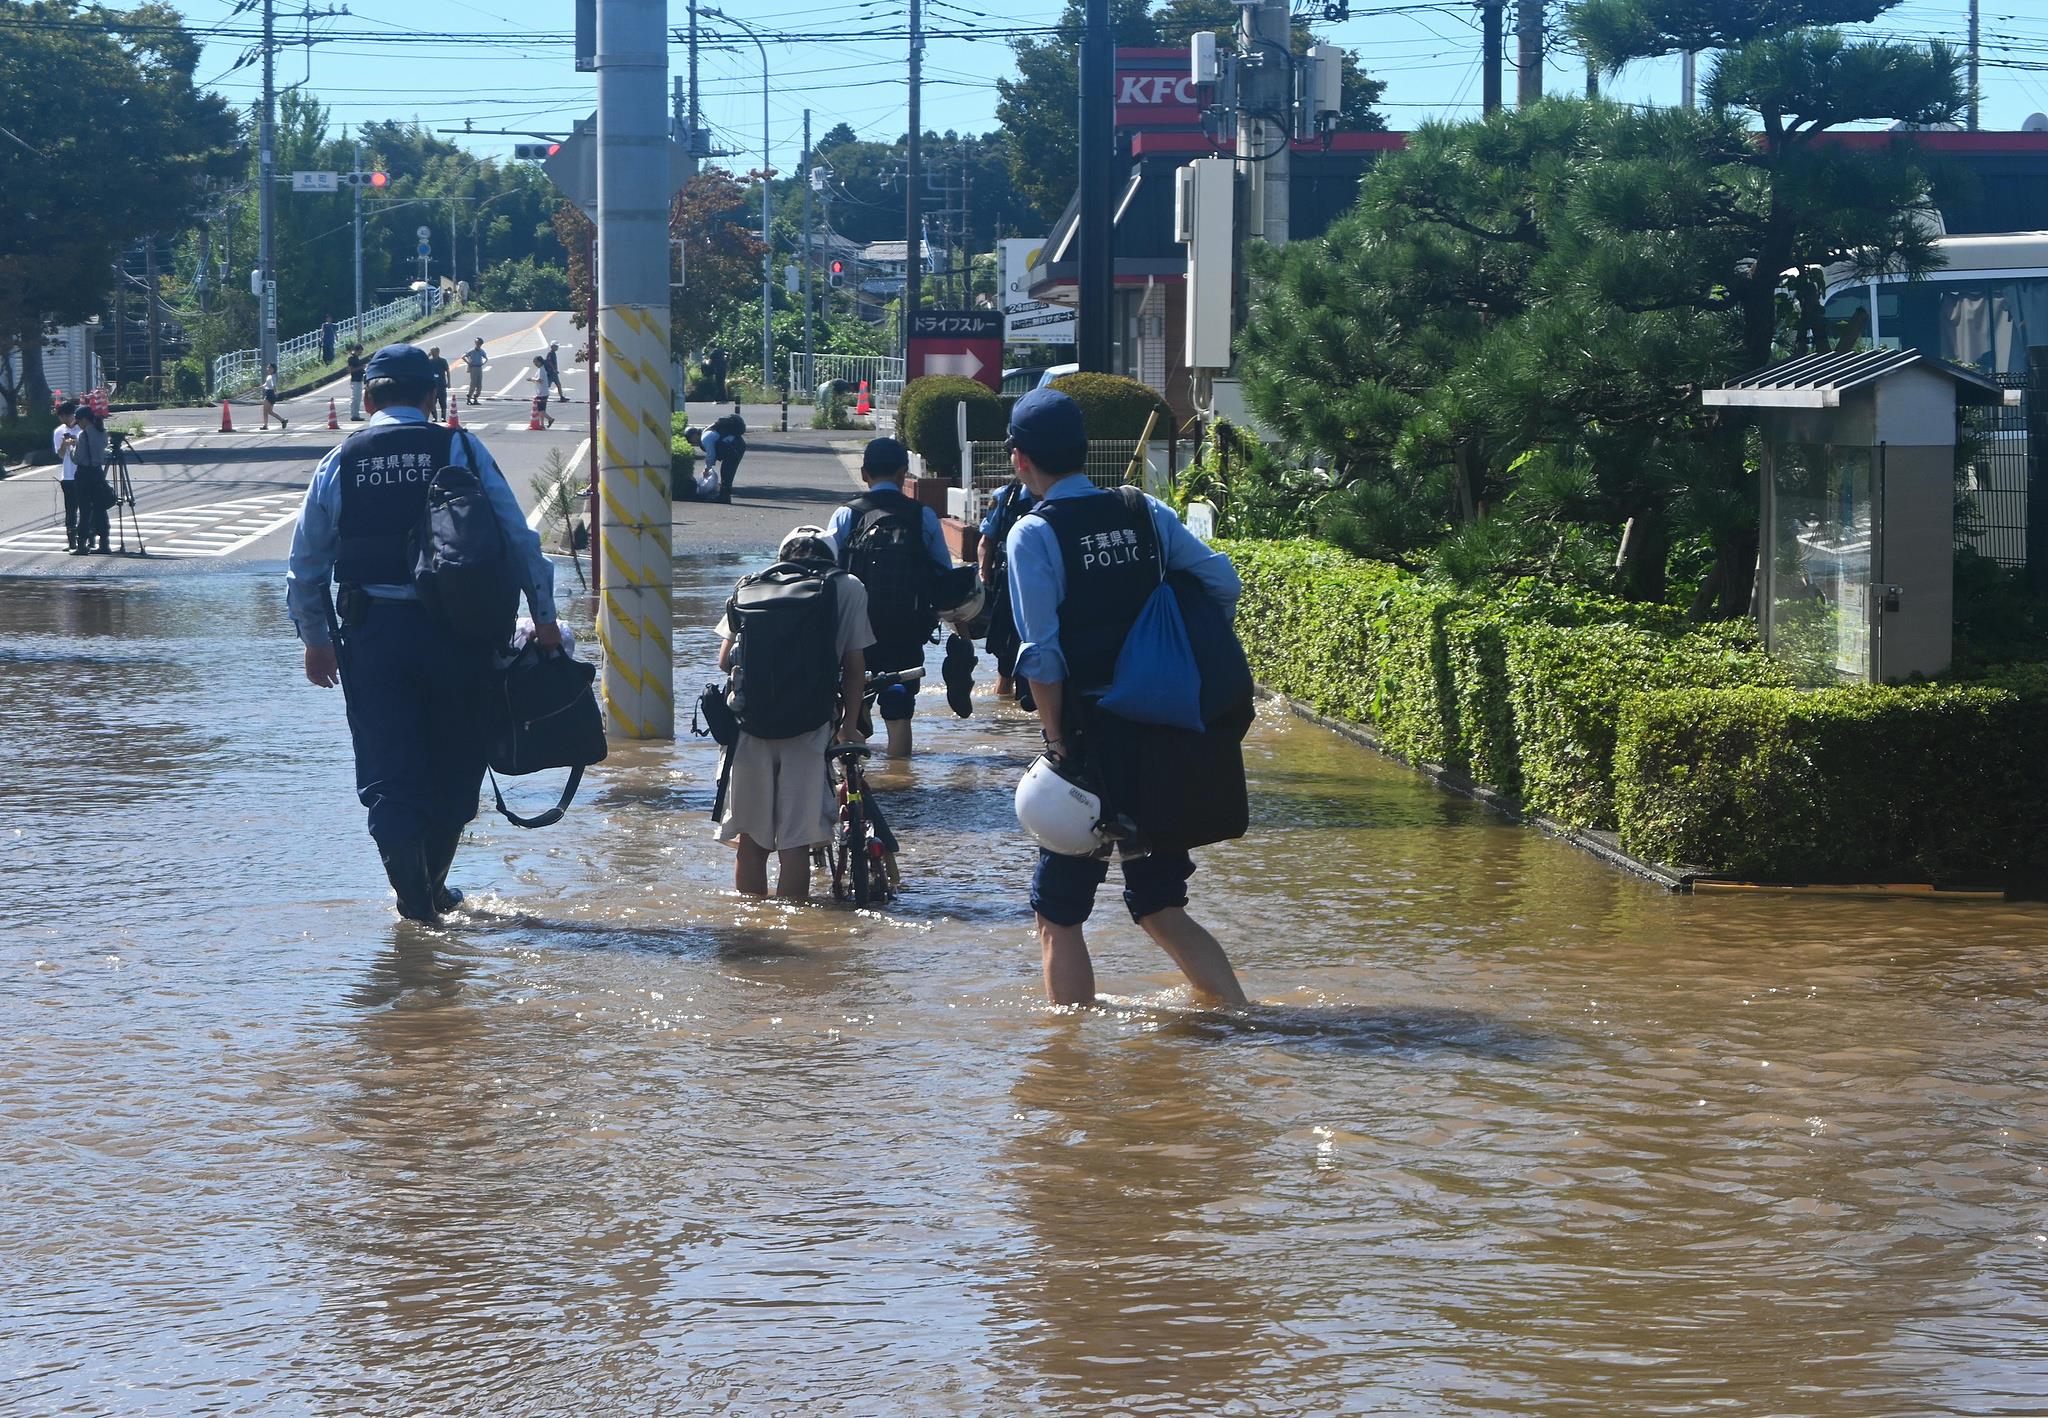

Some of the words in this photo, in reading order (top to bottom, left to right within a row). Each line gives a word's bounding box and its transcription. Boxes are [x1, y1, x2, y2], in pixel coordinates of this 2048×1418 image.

[1118, 77, 1197, 104] KFC
[915, 316, 997, 331] ドライブスルー
[356, 453, 432, 473] 千葉県警察
[356, 468, 432, 488] POLICE
[1080, 529, 1138, 552] 千葉県警
[1083, 544, 1155, 570] POLIC
